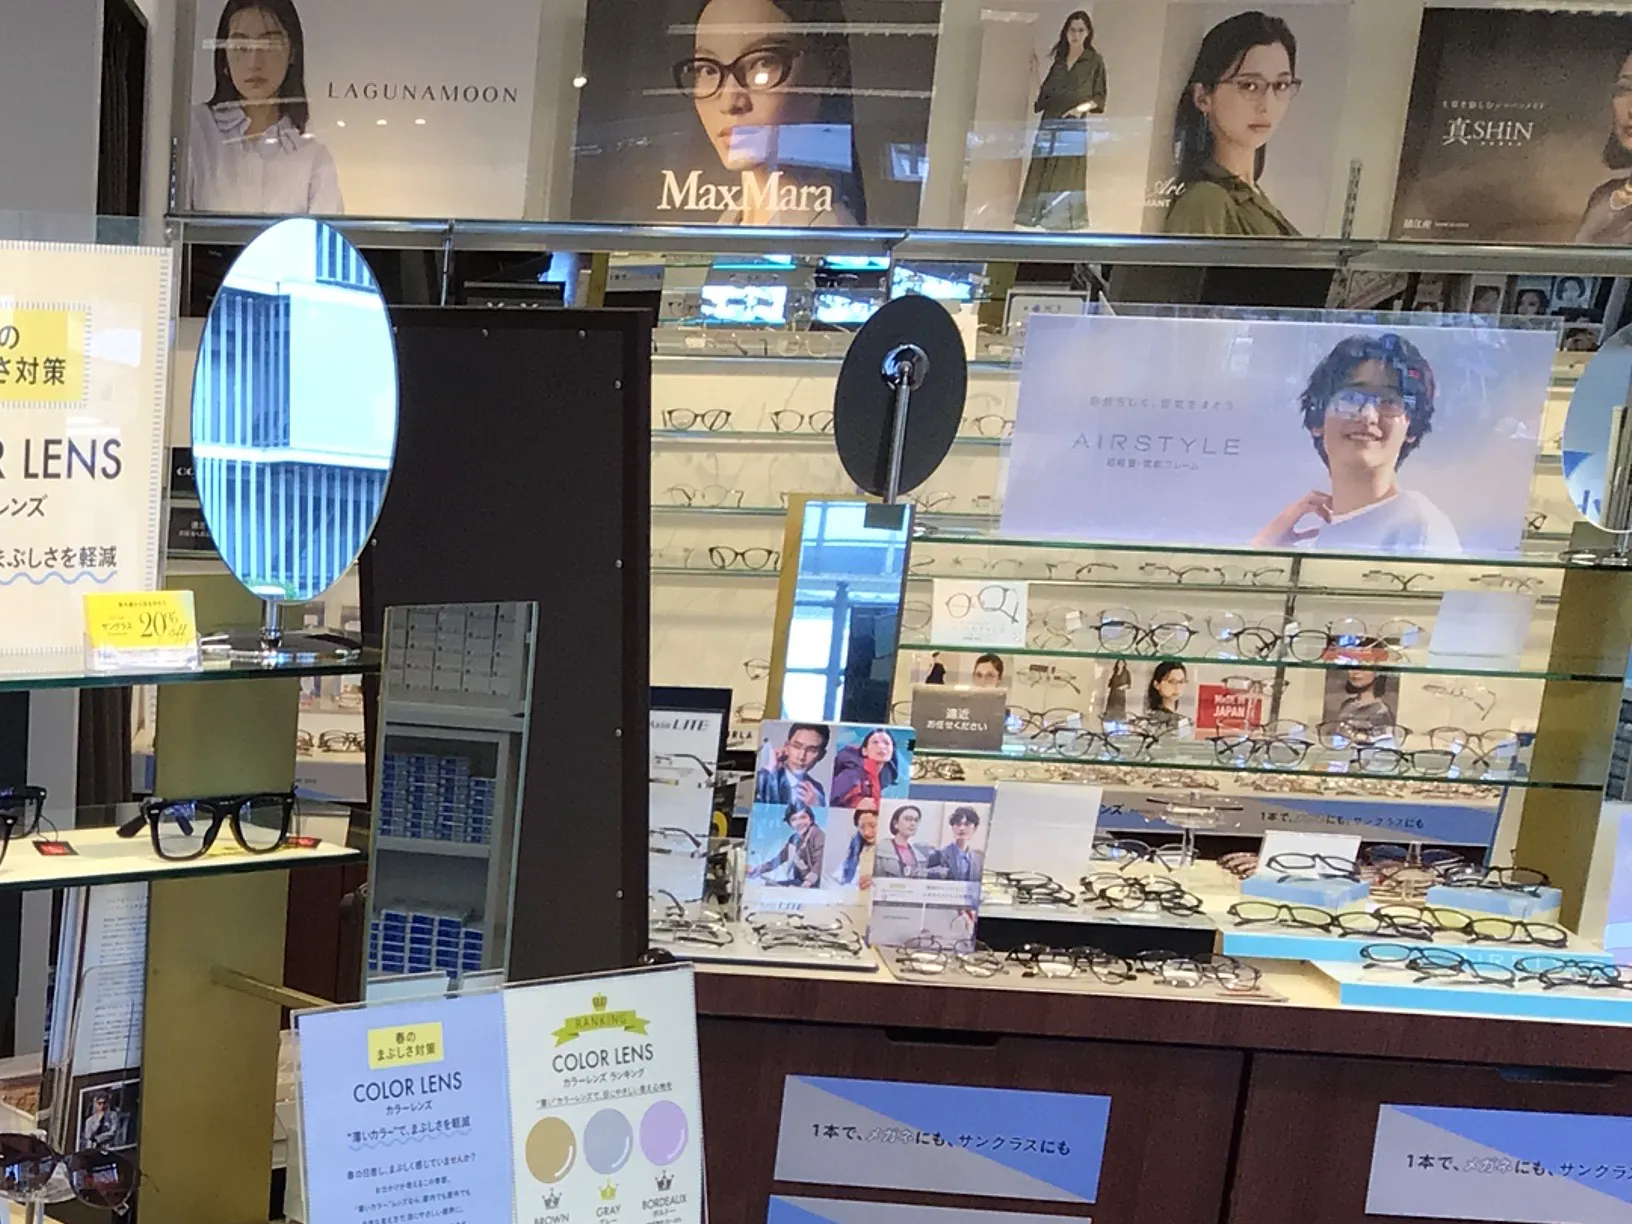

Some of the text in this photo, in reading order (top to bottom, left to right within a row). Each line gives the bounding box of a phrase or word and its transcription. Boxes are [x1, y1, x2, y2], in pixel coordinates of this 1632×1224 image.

[327, 81, 519, 104] LAGUNAMOON
[657, 170, 833, 213] MaxMara
[1072, 432, 1241, 456] AIRSTYLE
[24, 437, 123, 480] LENS
[395, 1032, 416, 1045] 春の
[377, 1042, 436, 1062] まぶしさ対策
[552, 1042, 654, 1073] COLOR LENS
[353, 1071, 463, 1103] COLOR LENS
[563, 1067, 645, 1088] カラーレンズ ランキング
[385, 1100, 433, 1116] カラーレンズ
[1406, 1153, 1632, 1180] 1本で、メガネにも、サングラ
[596, 1204, 622, 1218] GRAY
